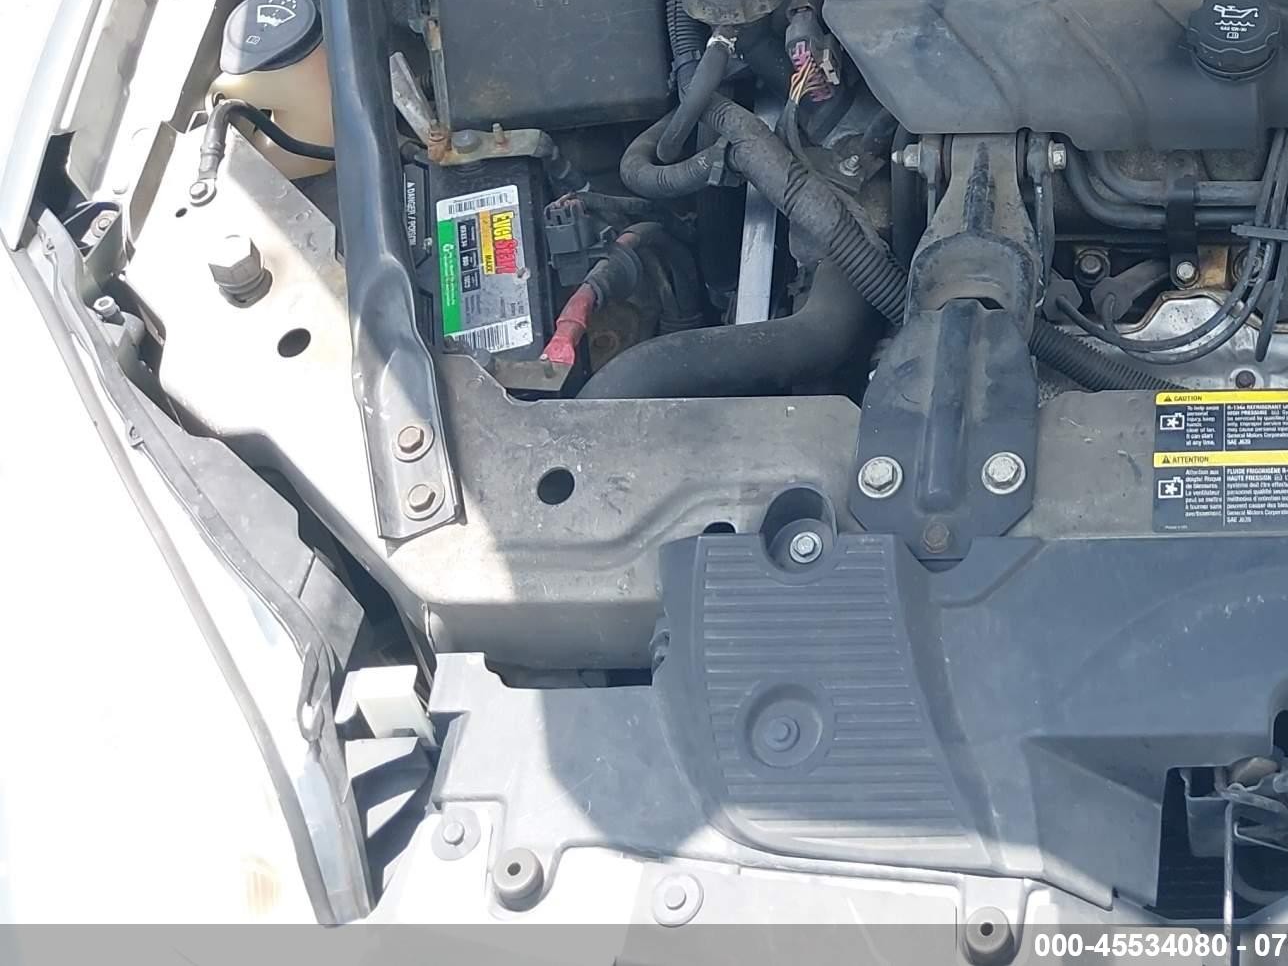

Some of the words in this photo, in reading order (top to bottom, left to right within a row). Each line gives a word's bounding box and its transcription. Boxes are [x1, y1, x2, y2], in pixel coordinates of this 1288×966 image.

[408, 188, 416, 215] DANGER
[492, 210, 519, 274] EverStart
[484, 254, 494, 273] MAXX
[1173, 456, 1208, 464] ATTENTION
